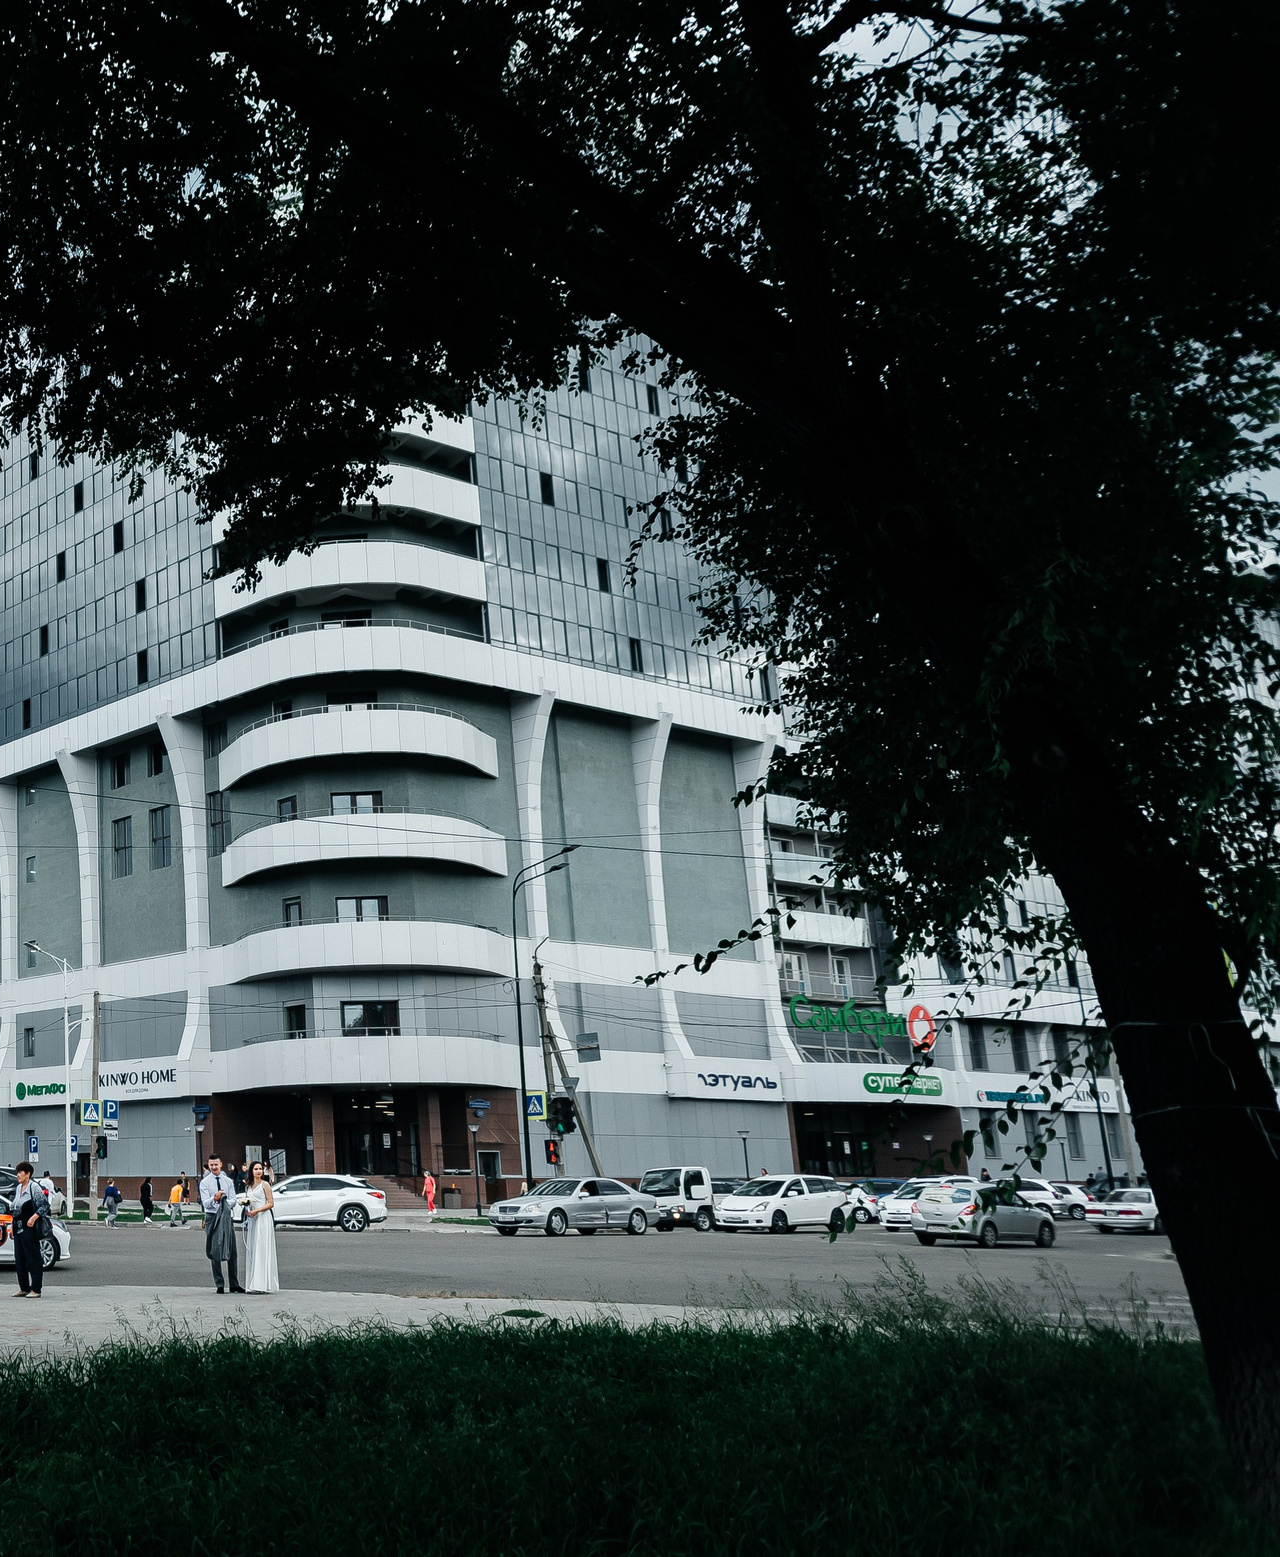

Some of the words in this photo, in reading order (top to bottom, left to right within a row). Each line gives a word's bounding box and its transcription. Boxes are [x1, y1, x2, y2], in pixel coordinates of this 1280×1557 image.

[790, 994, 905, 1047] Самбери
[98, 1071, 138, 1087] KINWO
[141, 1069, 176, 1084] HOME
[1075, 1090, 1110, 1103] KINO
